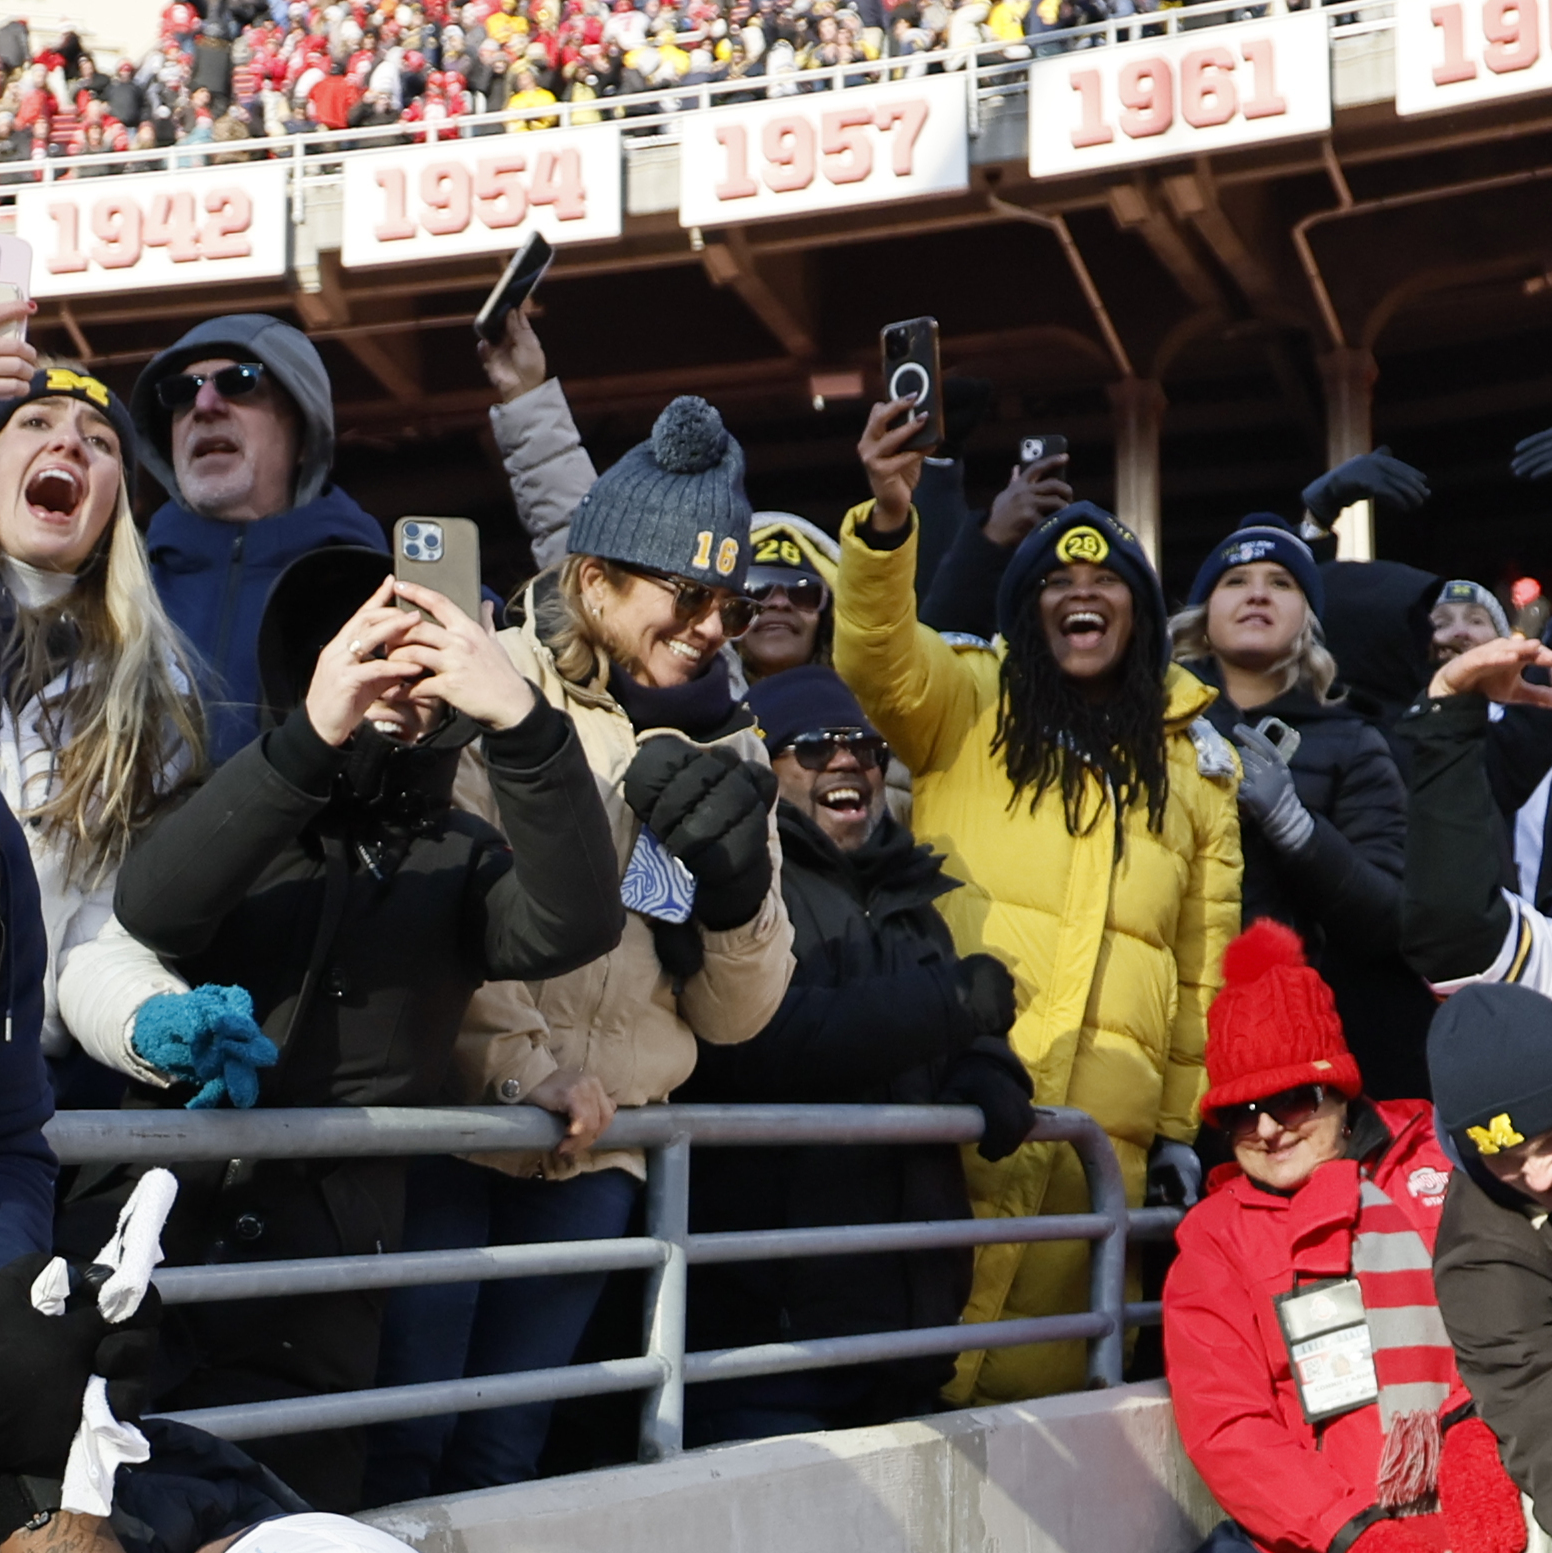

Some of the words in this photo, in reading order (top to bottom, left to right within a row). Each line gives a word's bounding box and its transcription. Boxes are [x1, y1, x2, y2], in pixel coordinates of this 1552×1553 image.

[1069, 38, 1288, 149] 1961
[714, 97, 930, 202] 1957
[374, 146, 588, 244] 1954
[45, 185, 253, 276] 1942
[46, 367, 110, 408] M
[691, 530, 740, 577] 16
[1067, 535, 1099, 557] 28
[1465, 1112, 1525, 1155] M
